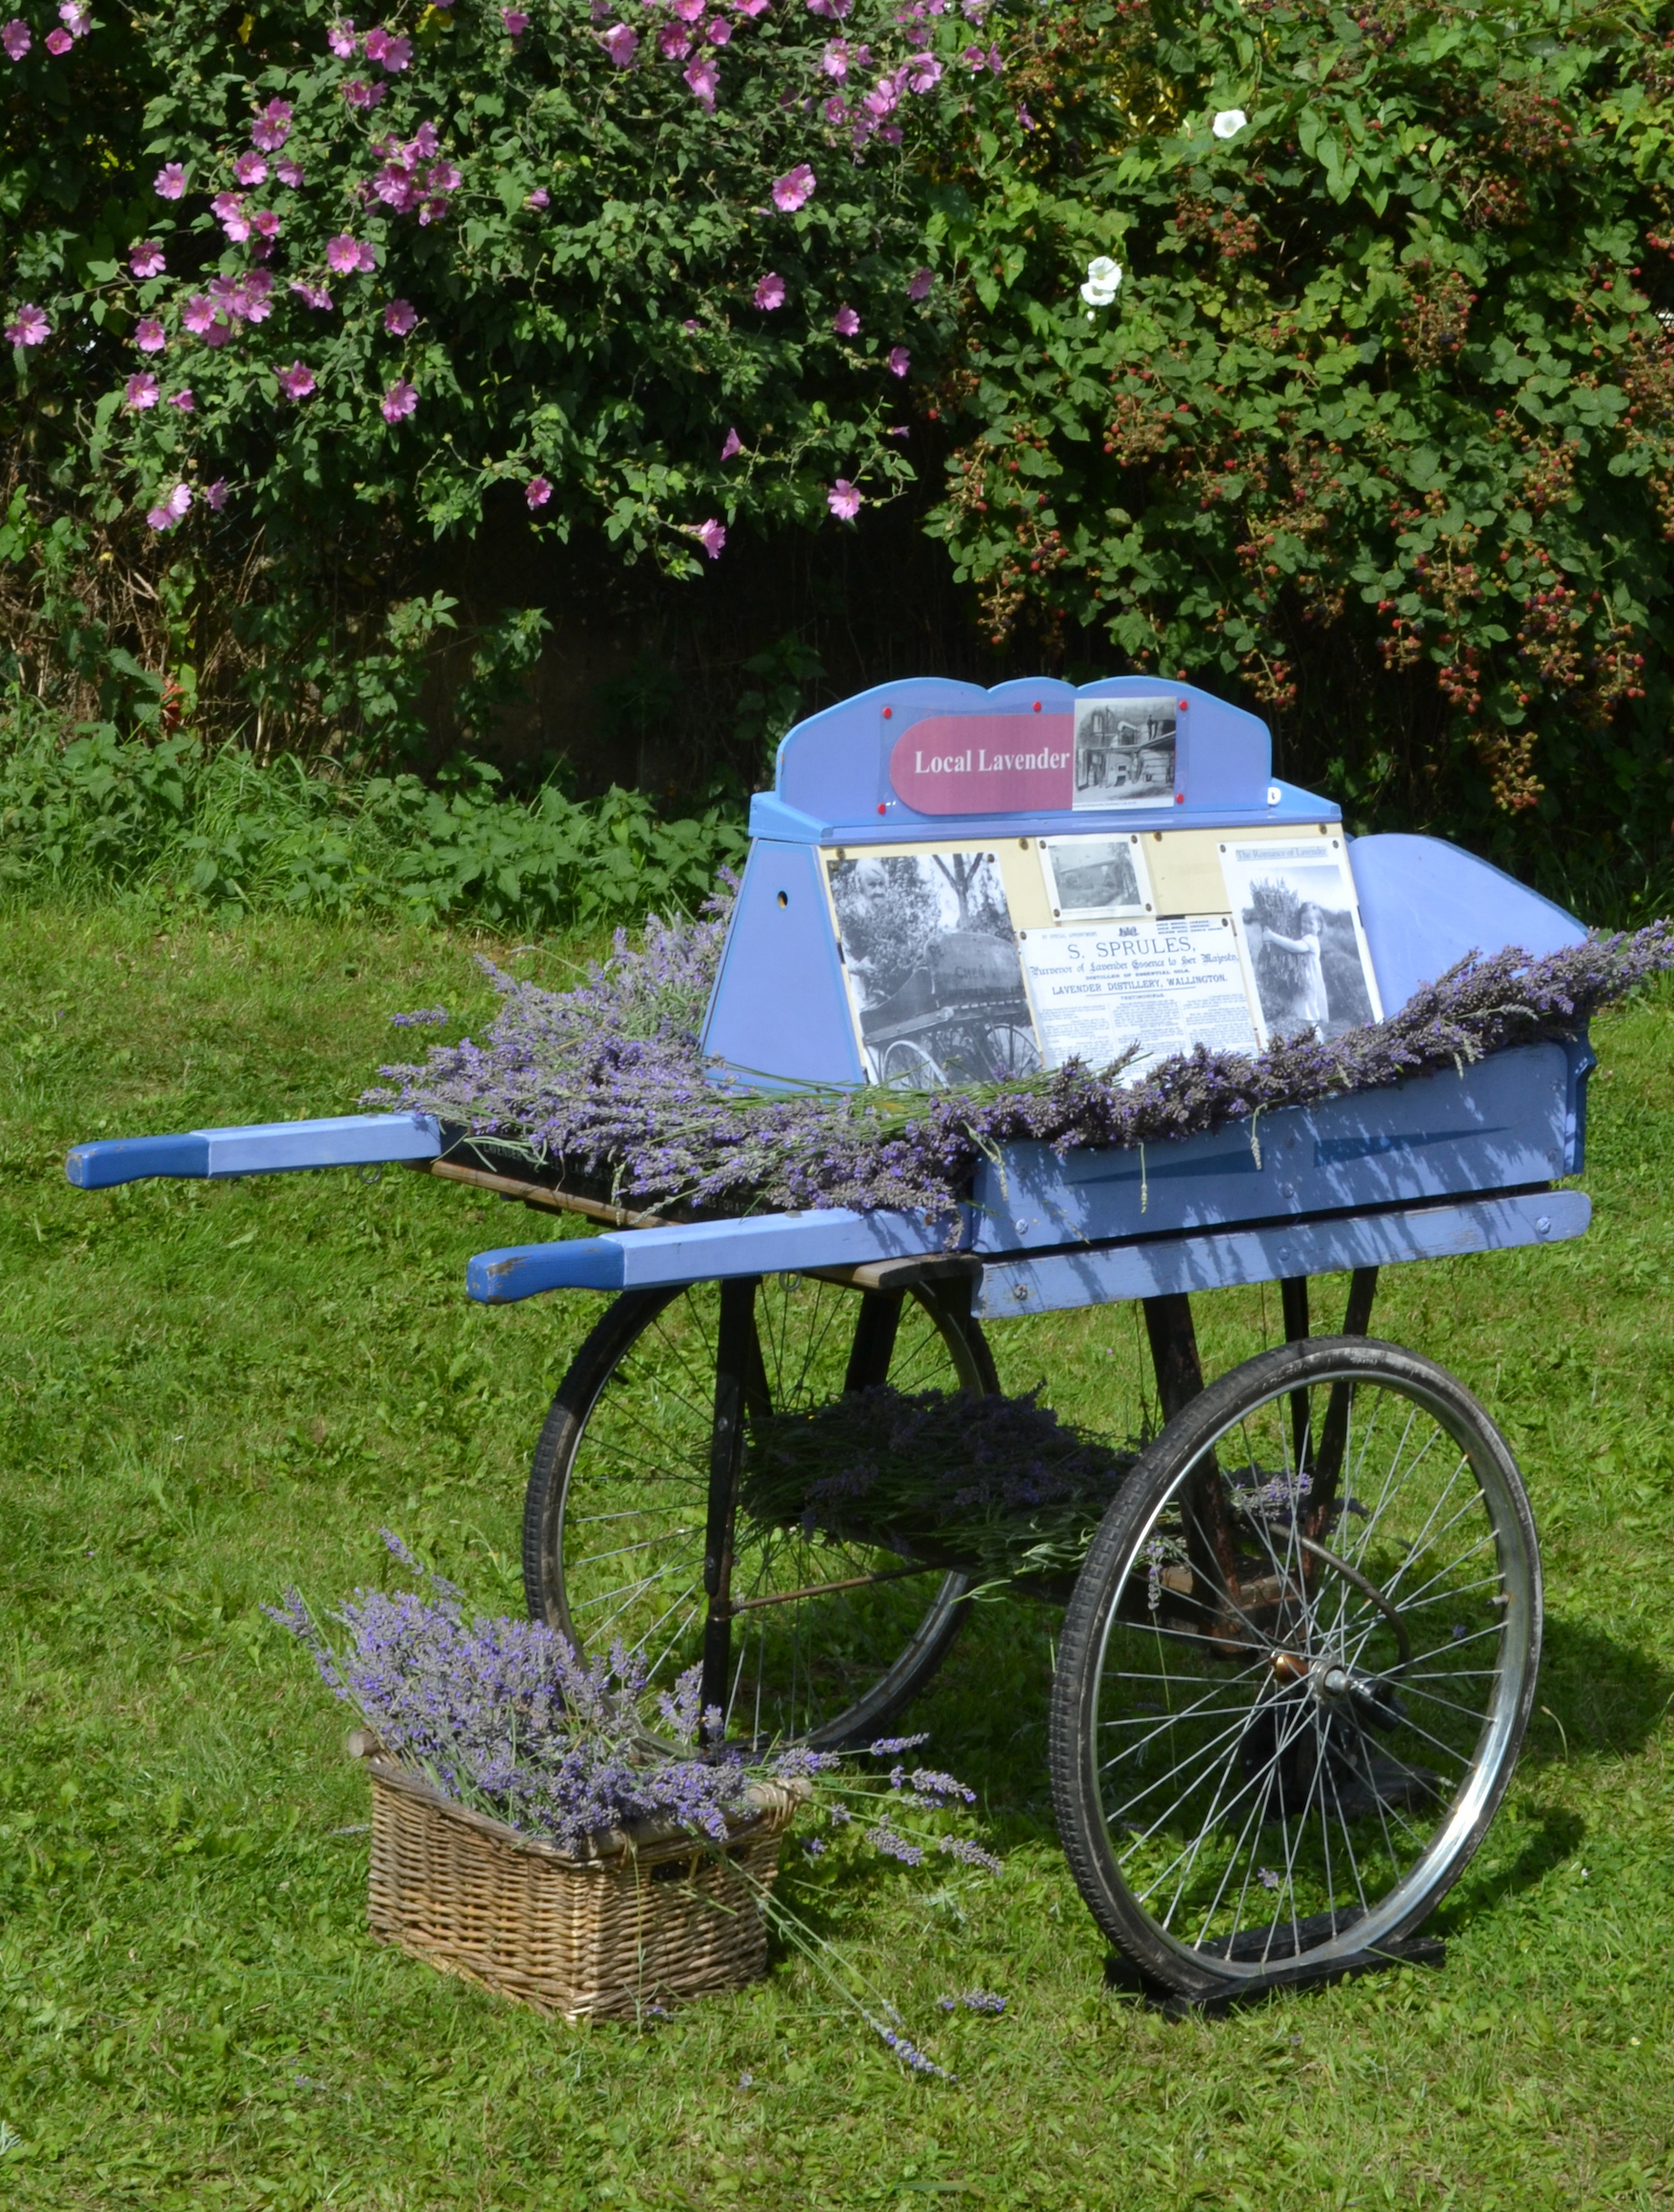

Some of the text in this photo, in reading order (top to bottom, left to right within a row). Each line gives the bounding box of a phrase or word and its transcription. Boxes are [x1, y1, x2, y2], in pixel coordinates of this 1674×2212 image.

[915, 747, 1070, 774] Local Lavender
[1067, 936, 1197, 960] S. SPRULES,
[1077, 963, 1084, 973] of
[1089, 961, 1128, 973] Lavender
[1131, 958, 1164, 970] Essence
[1168, 957, 1177, 966] to
[1181, 955, 1197, 966] Her
[1052, 973, 1228, 996] LAVENDER DISTILLERY, WALLINGTON.
